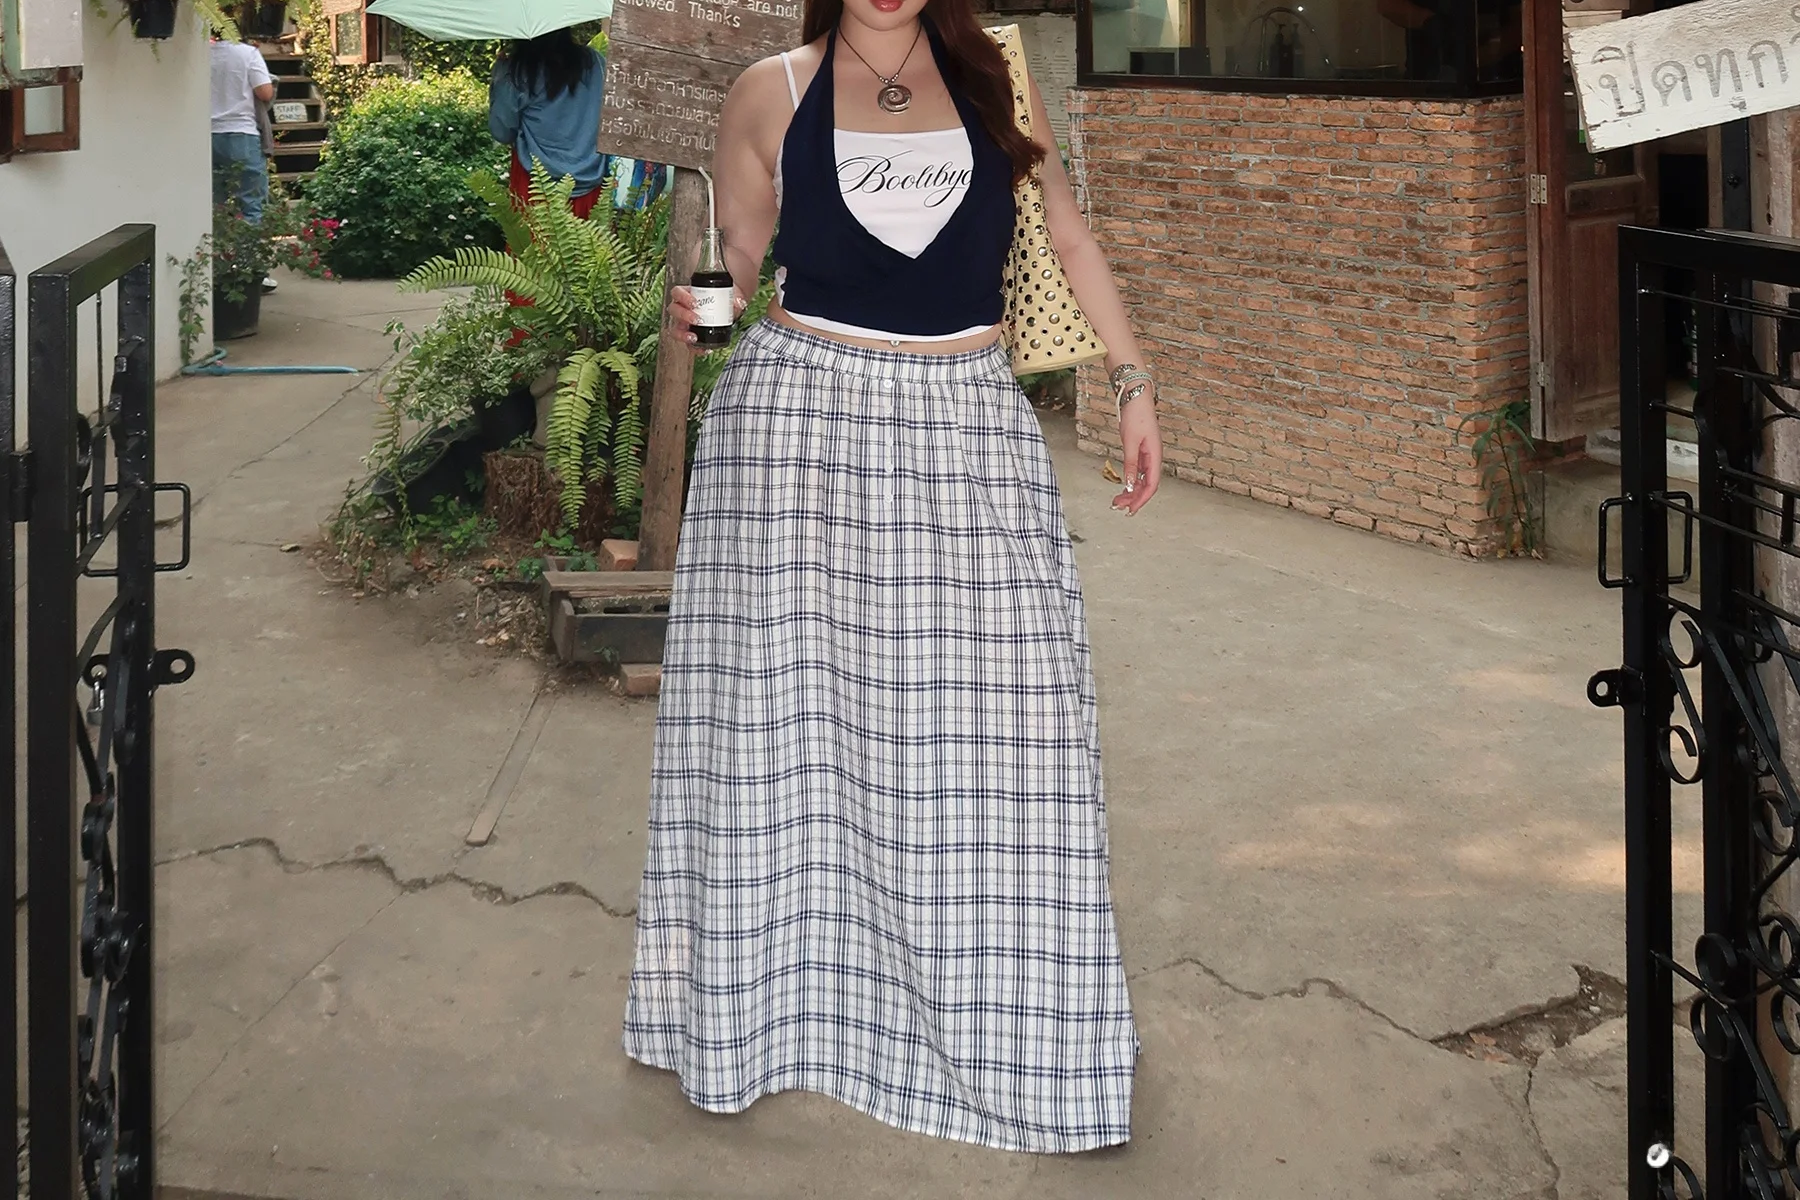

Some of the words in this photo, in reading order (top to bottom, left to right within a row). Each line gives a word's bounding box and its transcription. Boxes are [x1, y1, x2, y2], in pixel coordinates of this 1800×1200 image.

[688, 1, 741, 28] Thanks
[747, 0, 771, 14] are
[775, 3, 799, 20] not
[1590, 4, 1800, 116] ปิดทุก
